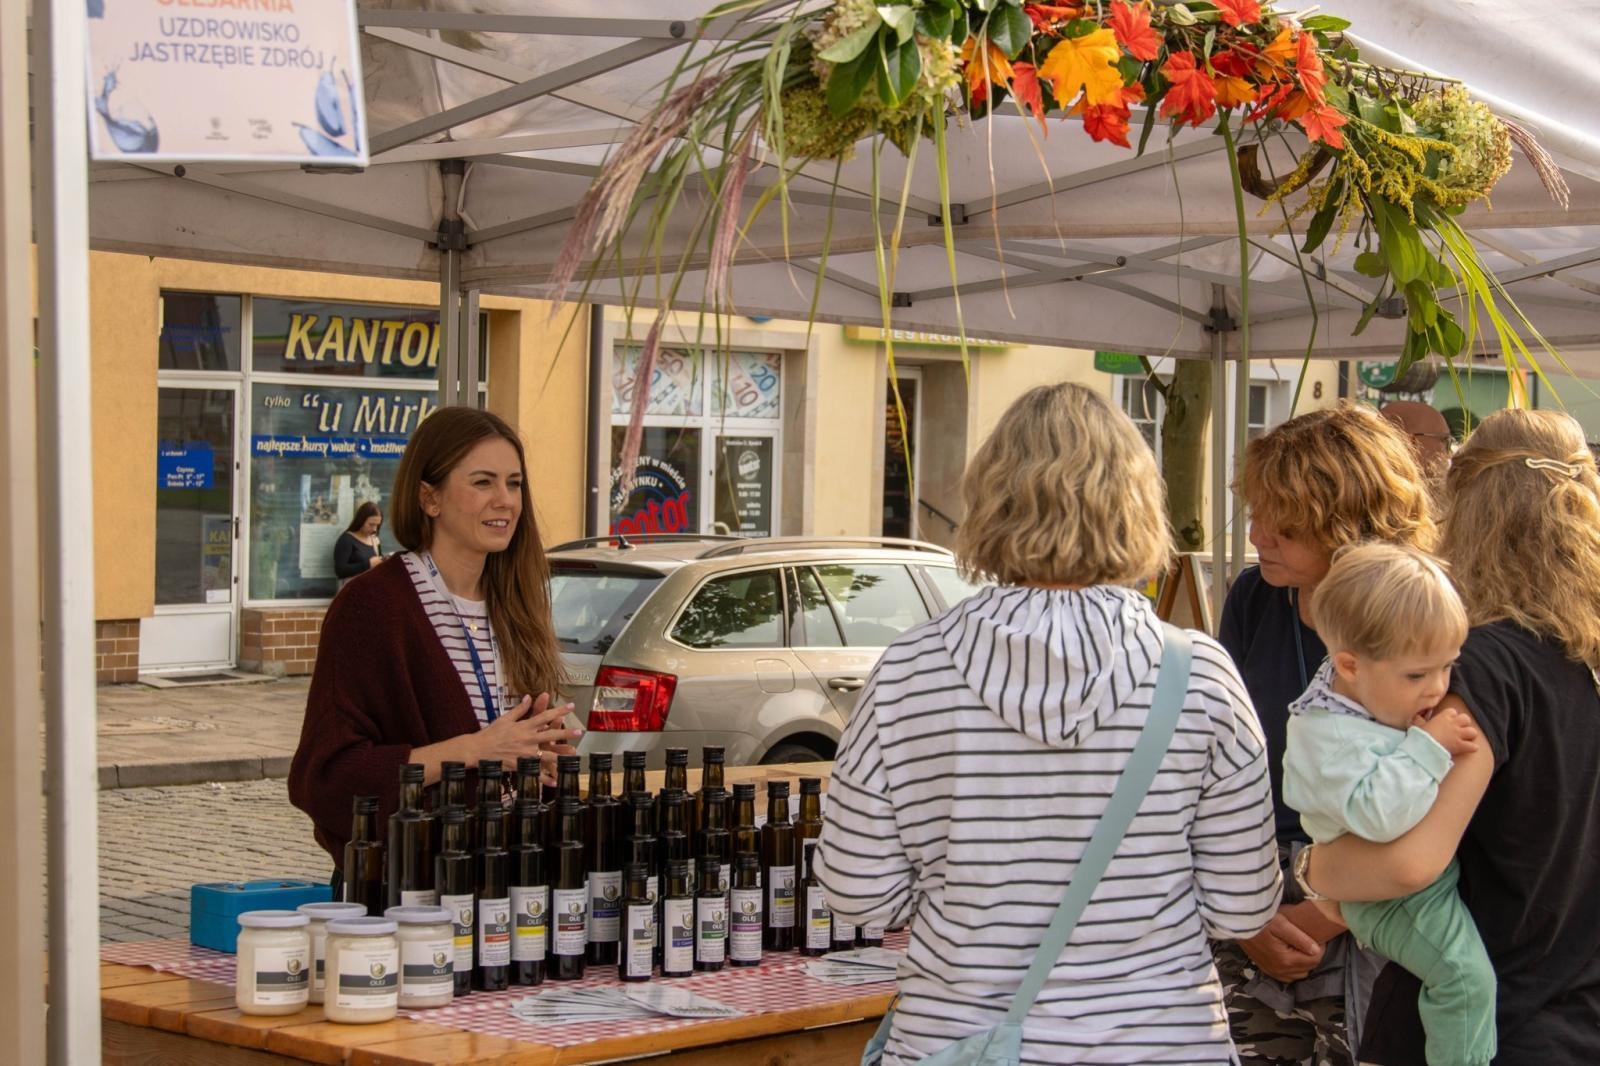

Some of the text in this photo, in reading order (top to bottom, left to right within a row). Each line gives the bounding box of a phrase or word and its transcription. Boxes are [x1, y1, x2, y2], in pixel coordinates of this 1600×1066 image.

[159, 17, 300, 43] UZDROWISKO
[129, 42, 325, 70] JASTRZĘBIE ZDRÓJ
[750, 365, 777, 392] 20
[1313, 381, 1322, 399] 8
[264, 395, 291, 409] tylko
[735, 382, 759, 407] 10
[256, 440, 300, 457] najlepsze
[301, 436, 329, 457] kursy
[330, 439, 356, 453] walut
[660, 461, 686, 490] mieście
